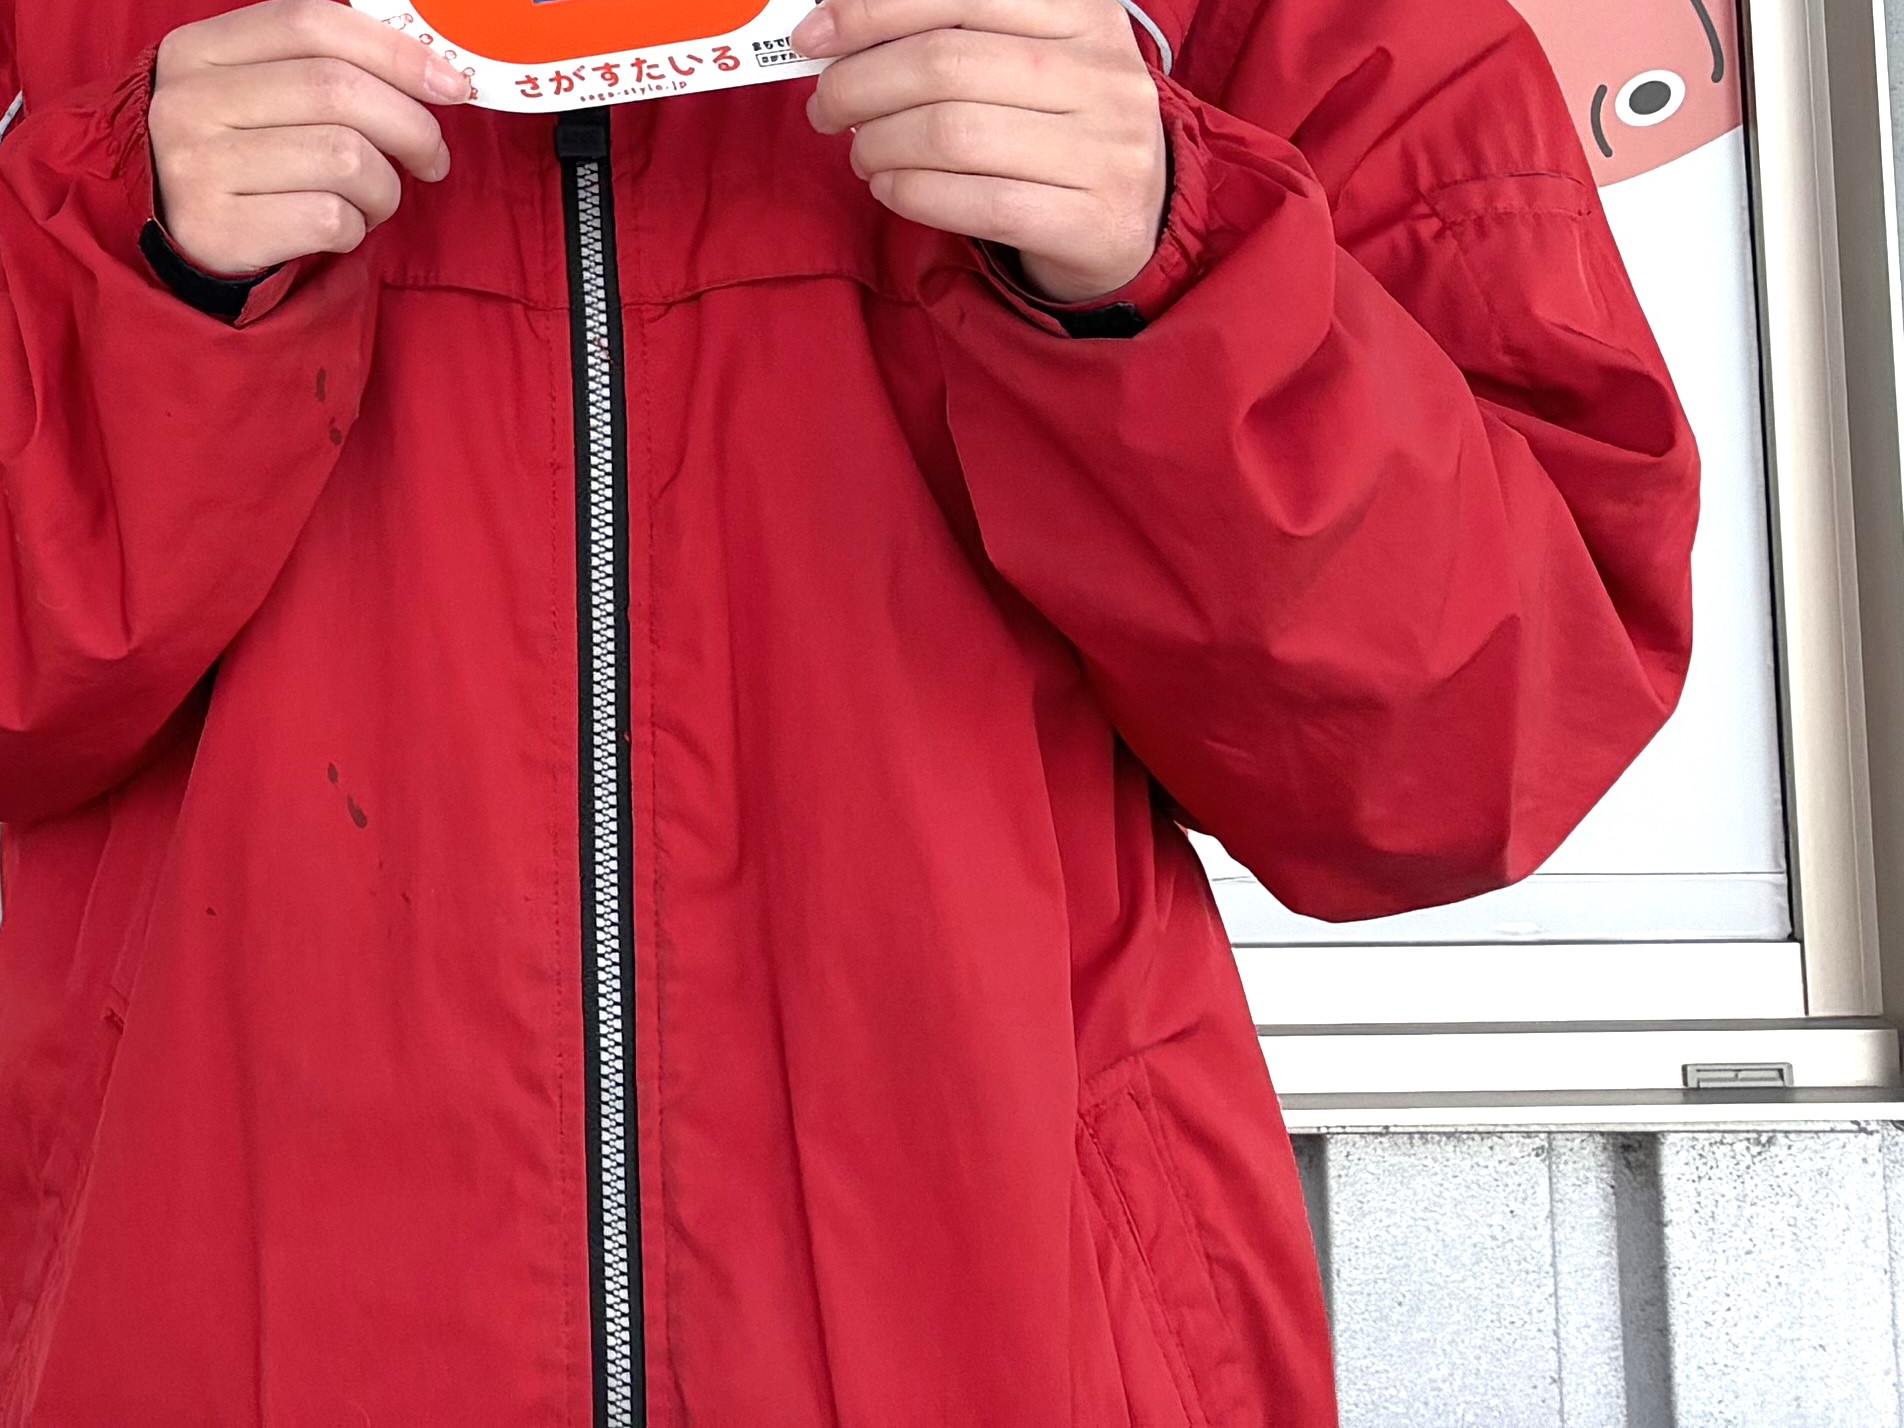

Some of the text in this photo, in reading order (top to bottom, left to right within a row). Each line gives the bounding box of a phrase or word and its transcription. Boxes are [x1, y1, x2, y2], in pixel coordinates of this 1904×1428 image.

[514, 45, 741, 99] さがすたいる
